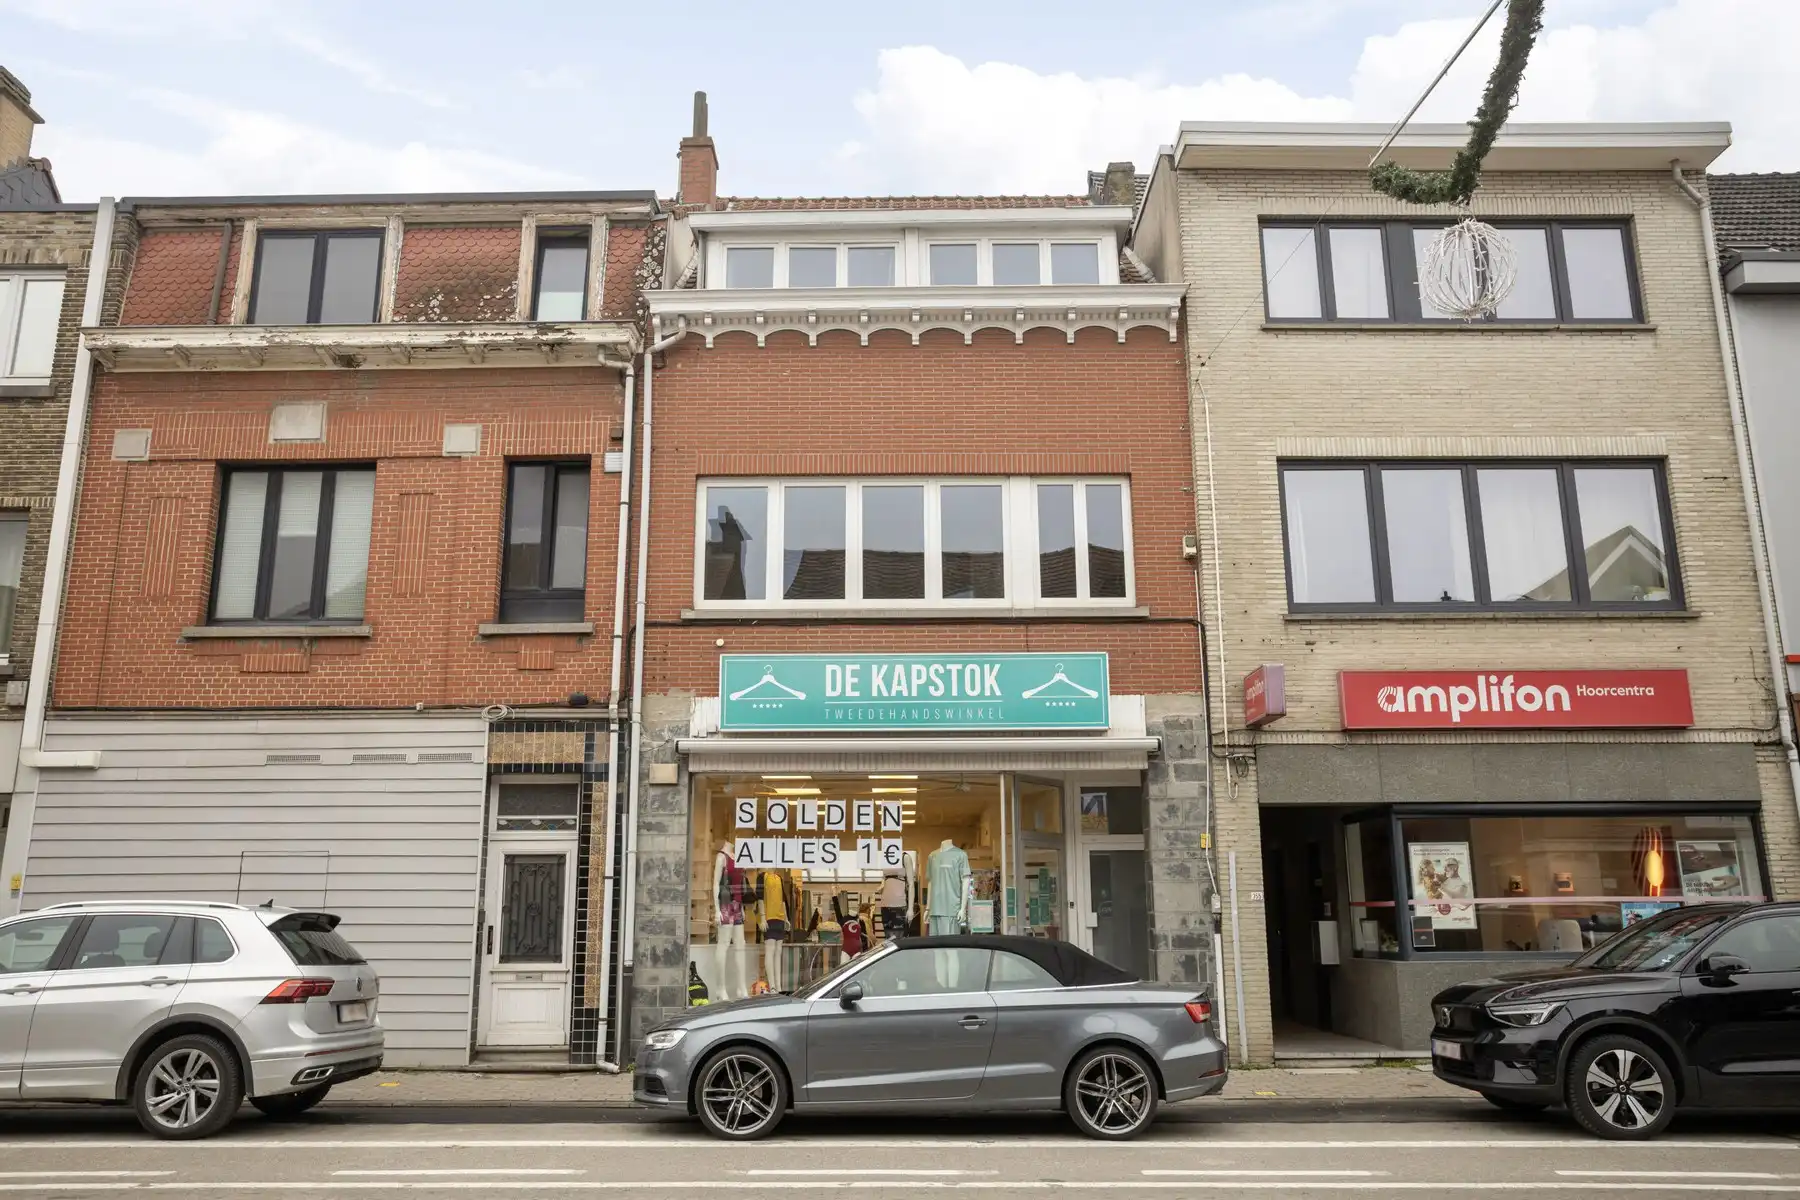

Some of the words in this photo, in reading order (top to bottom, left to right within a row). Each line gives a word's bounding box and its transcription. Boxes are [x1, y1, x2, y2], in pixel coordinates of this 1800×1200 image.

[825, 664, 861, 697] DE
[871, 663, 1002, 697] KAPSTOK
[1377, 674, 1572, 723] amplifon
[1576, 684, 1655, 697] Hoorcentra
[824, 708, 1004, 720] TWEEDEHANDSWINKEL
[738, 802, 901, 827] SOLDEN
[736, 841, 837, 864] ALLES
[861, 843, 900, 866] 1€
